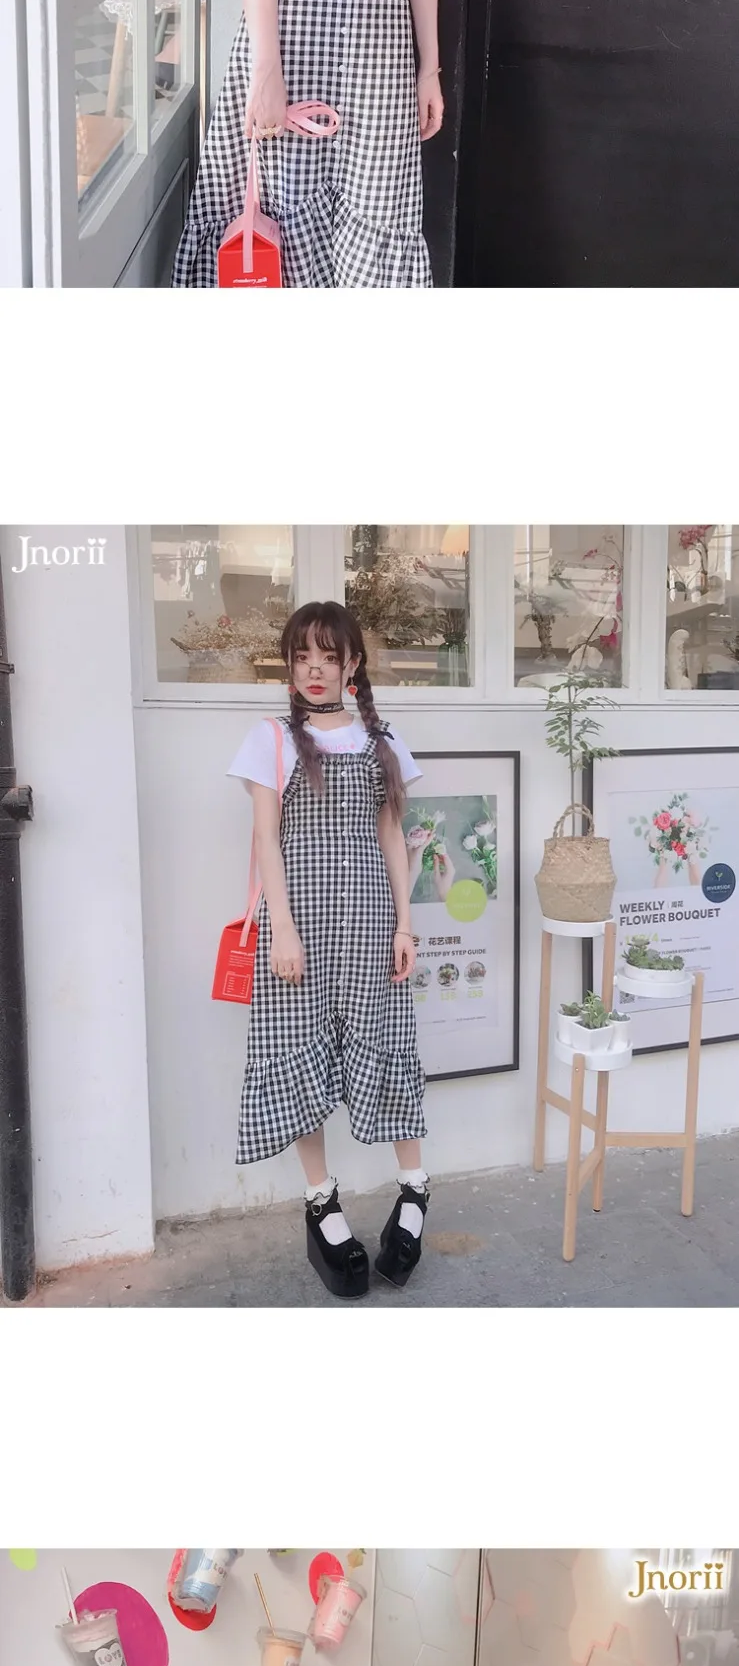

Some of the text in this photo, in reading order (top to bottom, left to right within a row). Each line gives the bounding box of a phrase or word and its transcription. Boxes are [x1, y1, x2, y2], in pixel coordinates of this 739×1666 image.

[619, 901, 665, 913] WEEKLY
[619, 908, 721, 927] FLOWER BOUQUET
[428, 936, 462, 946] 花艺课程
